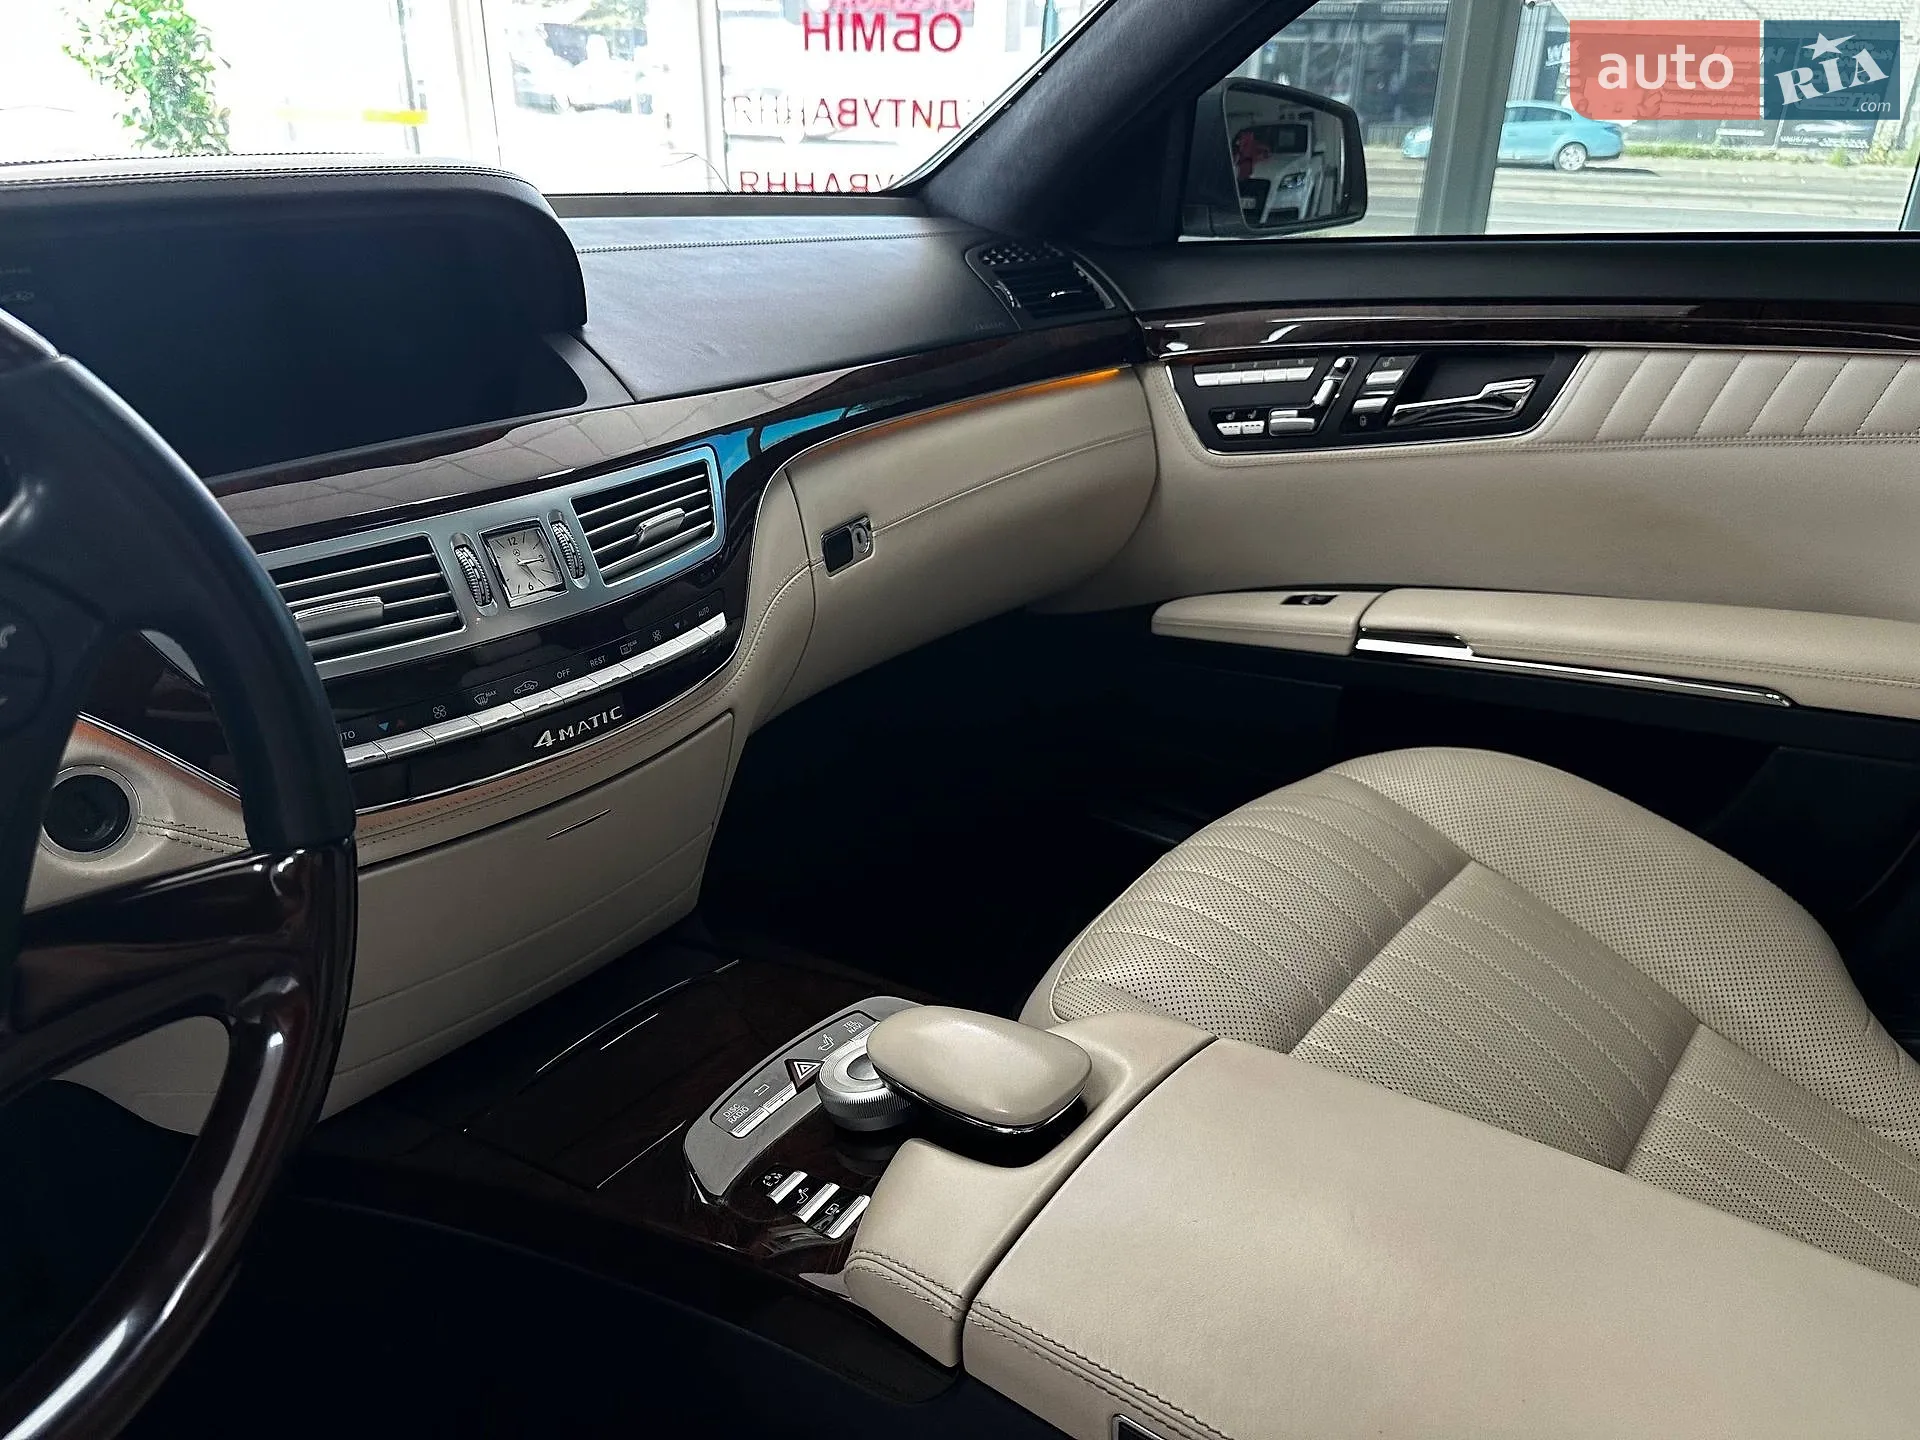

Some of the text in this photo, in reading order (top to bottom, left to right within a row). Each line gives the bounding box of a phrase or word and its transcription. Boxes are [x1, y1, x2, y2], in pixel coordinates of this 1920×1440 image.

[507, 536, 518, 546] 12
[589, 655, 606, 668] REST
[556, 667, 571, 679] OFF
[728, 1106, 749, 1124] RADIO
